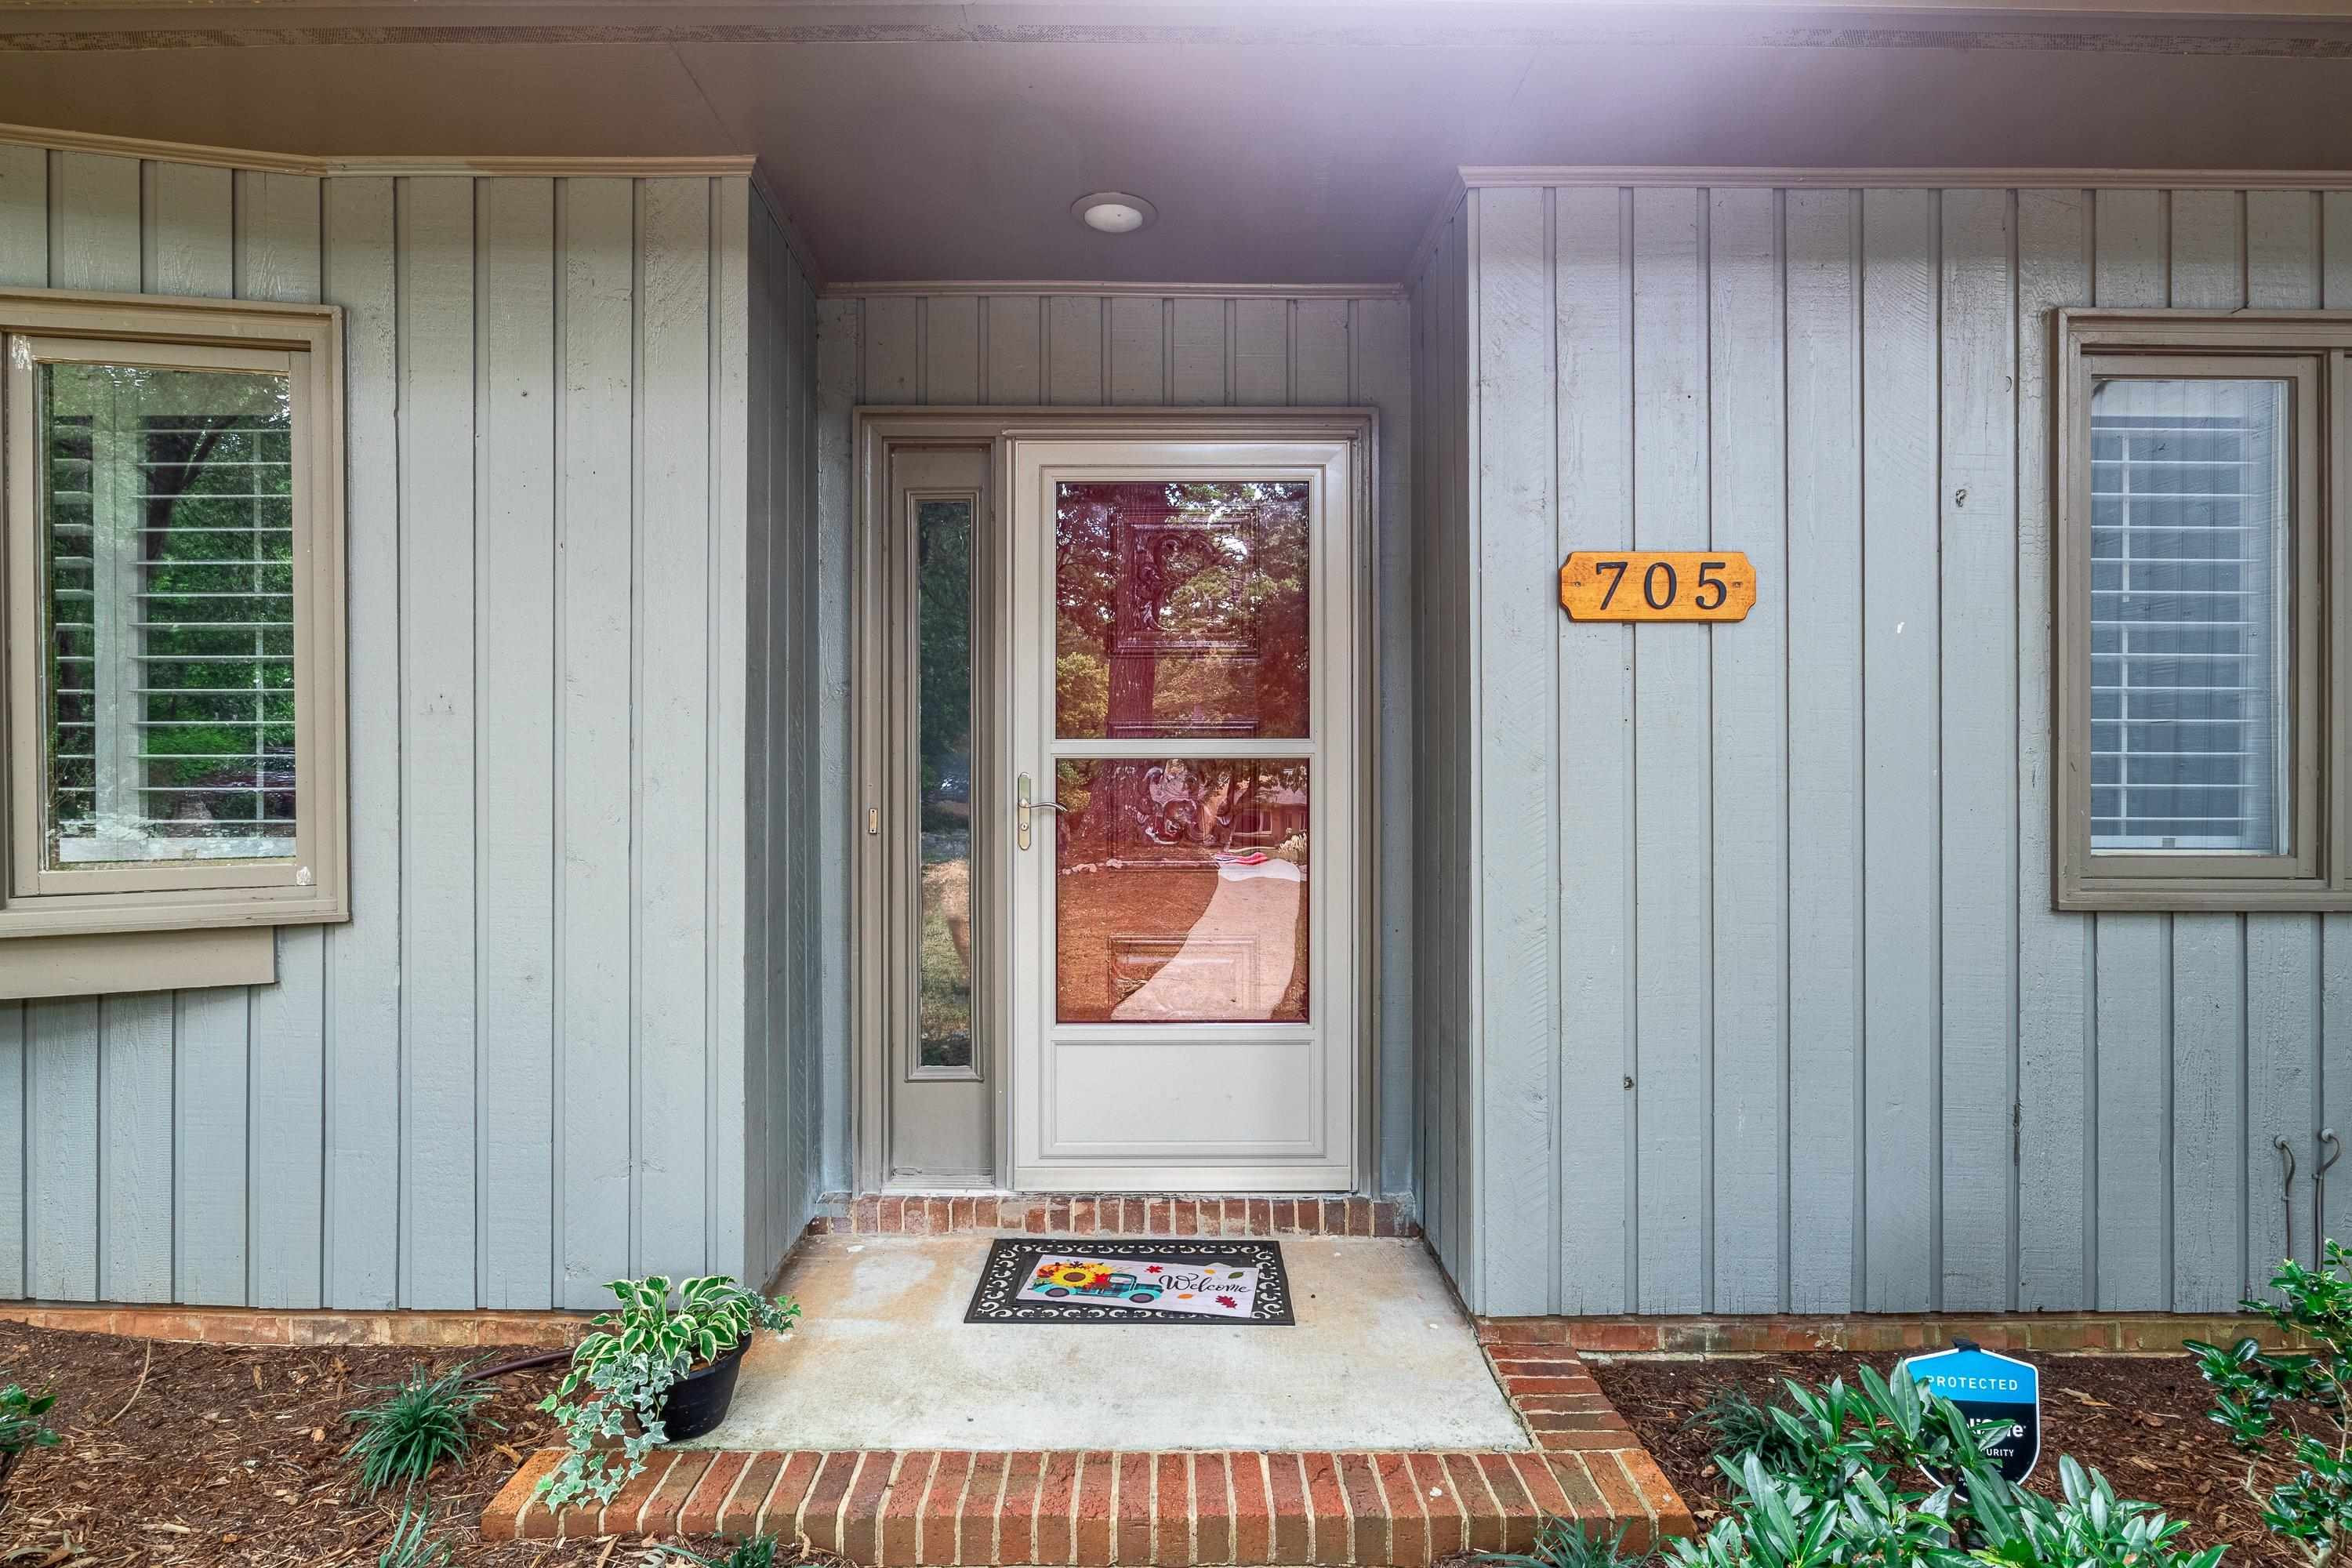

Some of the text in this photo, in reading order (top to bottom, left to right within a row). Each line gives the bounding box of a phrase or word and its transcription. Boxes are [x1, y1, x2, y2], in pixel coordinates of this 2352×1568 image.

[1595, 561, 1727, 610] 705
[1158, 1272, 1252, 1293] Welcome
[1926, 1375, 2018, 1391] PROTECTED
[1986, 1448, 2014, 1457] URITY
